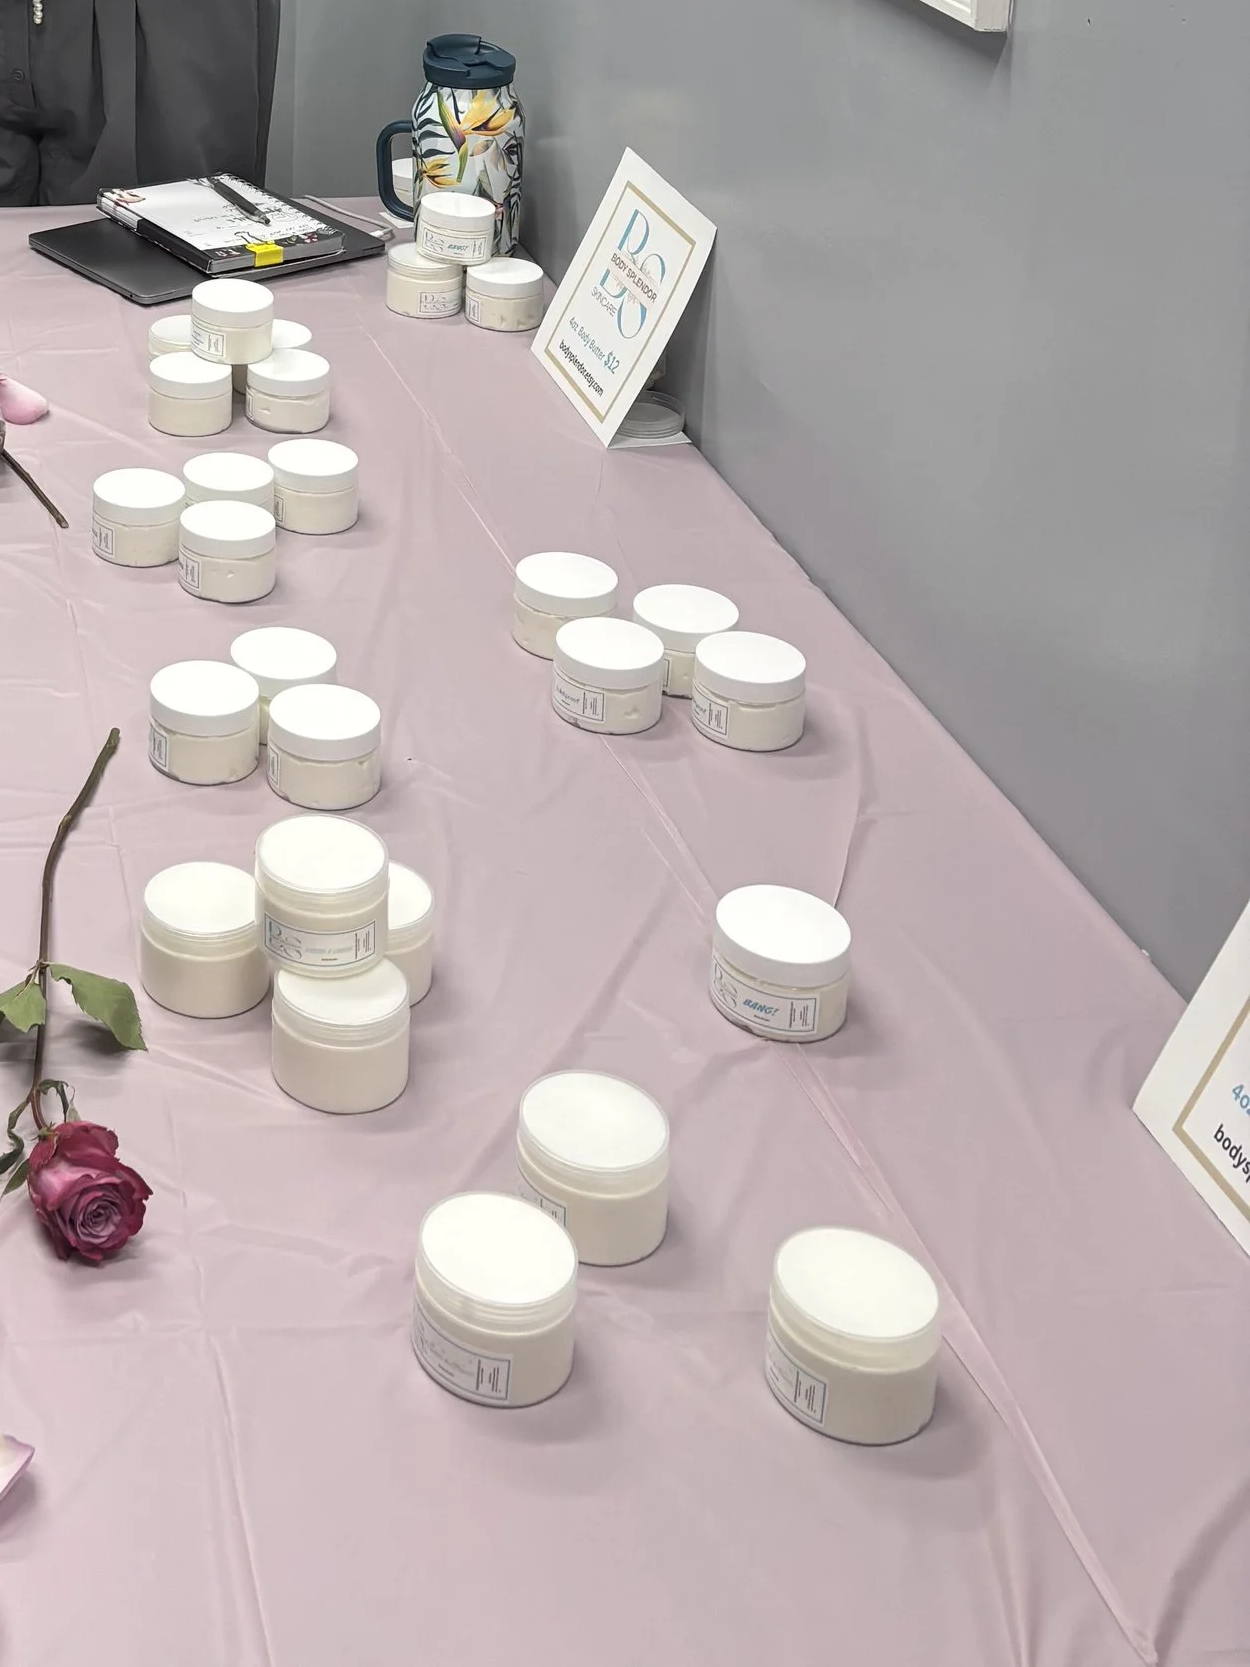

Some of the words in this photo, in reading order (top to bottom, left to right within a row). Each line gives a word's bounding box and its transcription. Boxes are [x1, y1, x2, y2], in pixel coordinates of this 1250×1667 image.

[591, 286, 618, 317] SKINCARE
[611, 253, 628, 272] BODY
[626, 268, 658, 303] SPLENDOR
[559, 339, 604, 397] bodysplendor.etsy.com
[569, 317, 579, 331] 4oz
[577, 326, 591, 347] Body
[589, 339, 606, 361] Butter
[604, 350, 620, 375] $12
[743, 998, 780, 1017] BANG!
[1232, 1084, 1250, 1117] 4o
[1213, 1123, 1250, 1183] bodys
